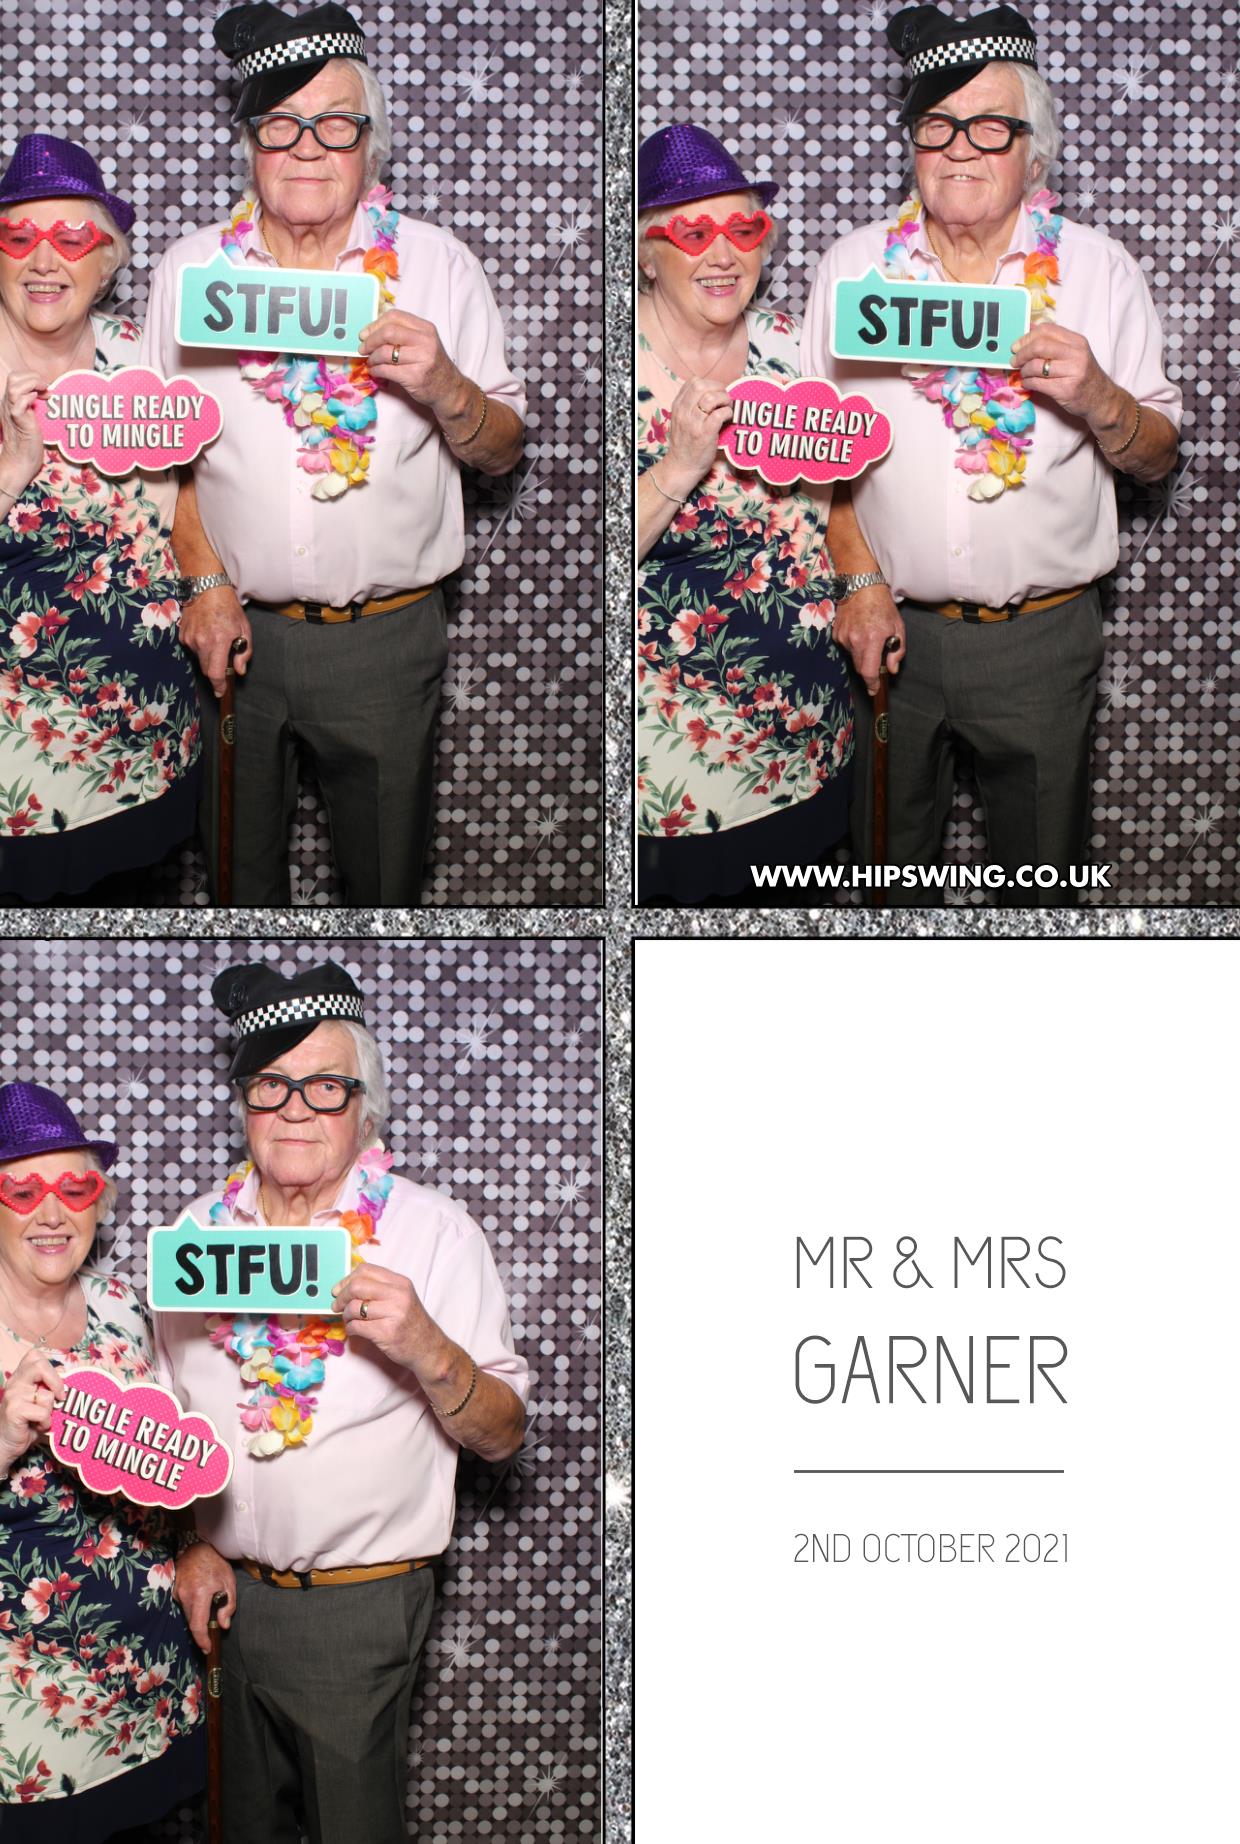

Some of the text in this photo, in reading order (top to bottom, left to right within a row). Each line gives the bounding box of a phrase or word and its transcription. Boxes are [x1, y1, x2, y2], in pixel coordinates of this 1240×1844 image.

[204, 280, 347, 340] STFU!
[858, 294, 999, 352] STFU!
[47, 393, 205, 420] SINGLE READY
[732, 399, 878, 437] INGLE READY
[66, 423, 185, 449] TO MINGLE
[735, 429, 854, 464] TO MINGLE
[175, 1243, 318, 1298] STFU!
[61, 1420, 185, 1491] TO MINGLE
[135, 1415, 217, 1469] READY
